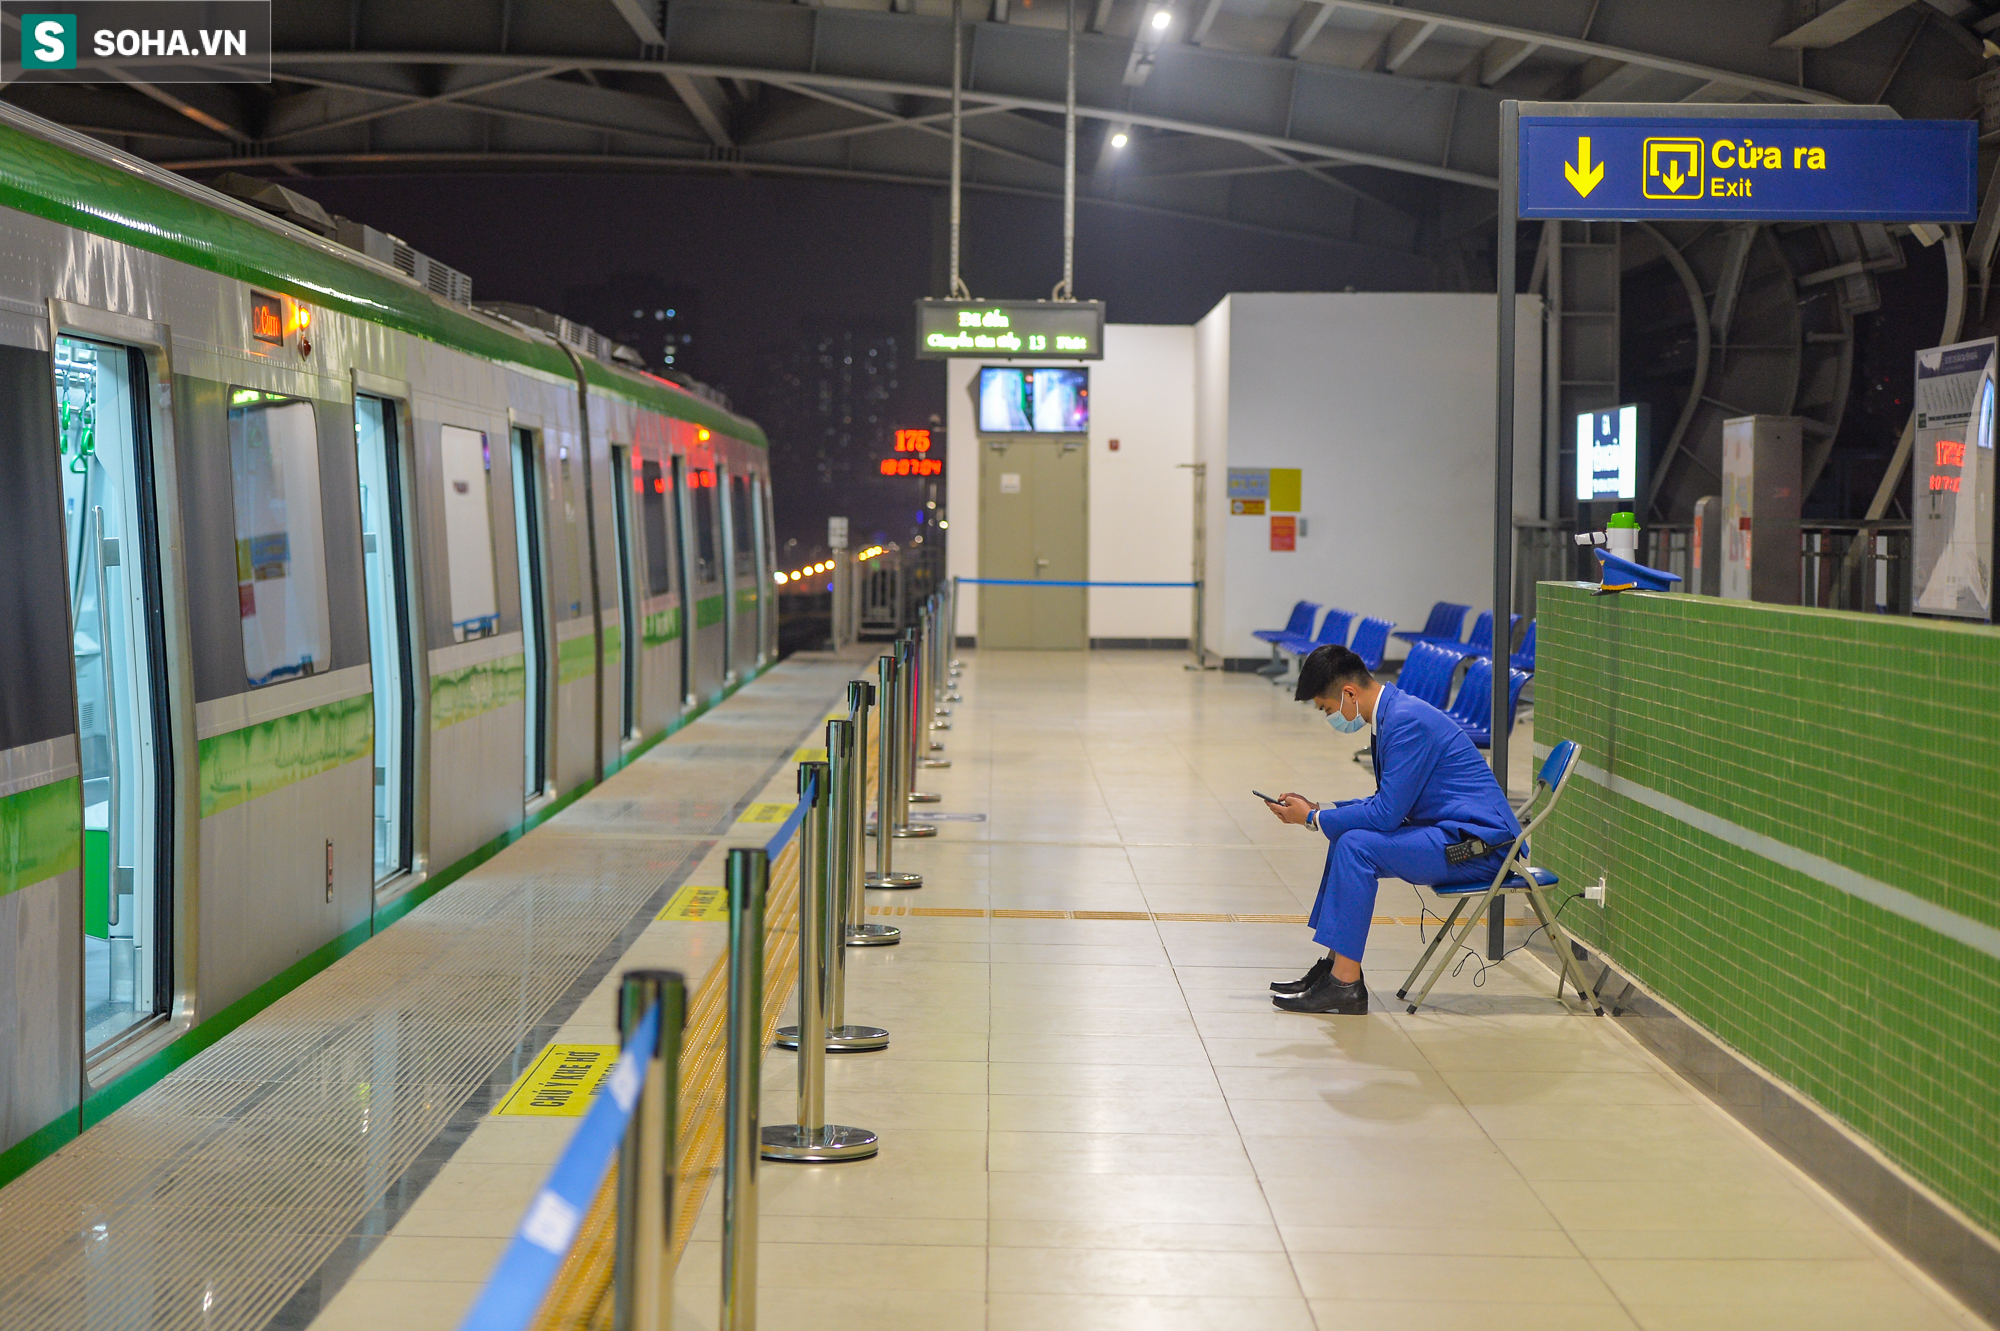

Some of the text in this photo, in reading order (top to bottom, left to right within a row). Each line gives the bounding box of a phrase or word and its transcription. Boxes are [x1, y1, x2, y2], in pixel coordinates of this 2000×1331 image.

[1711, 138, 1826, 170] Cửa ra
[1711, 178, 1752, 197] Exit
[1029, 335, 1046, 350] 13
[894, 429, 931, 452] 175
[555, 1050, 601, 1062] HỞ
[550, 1064, 593, 1080] KHE
[529, 1089, 574, 1107] CHÚ
